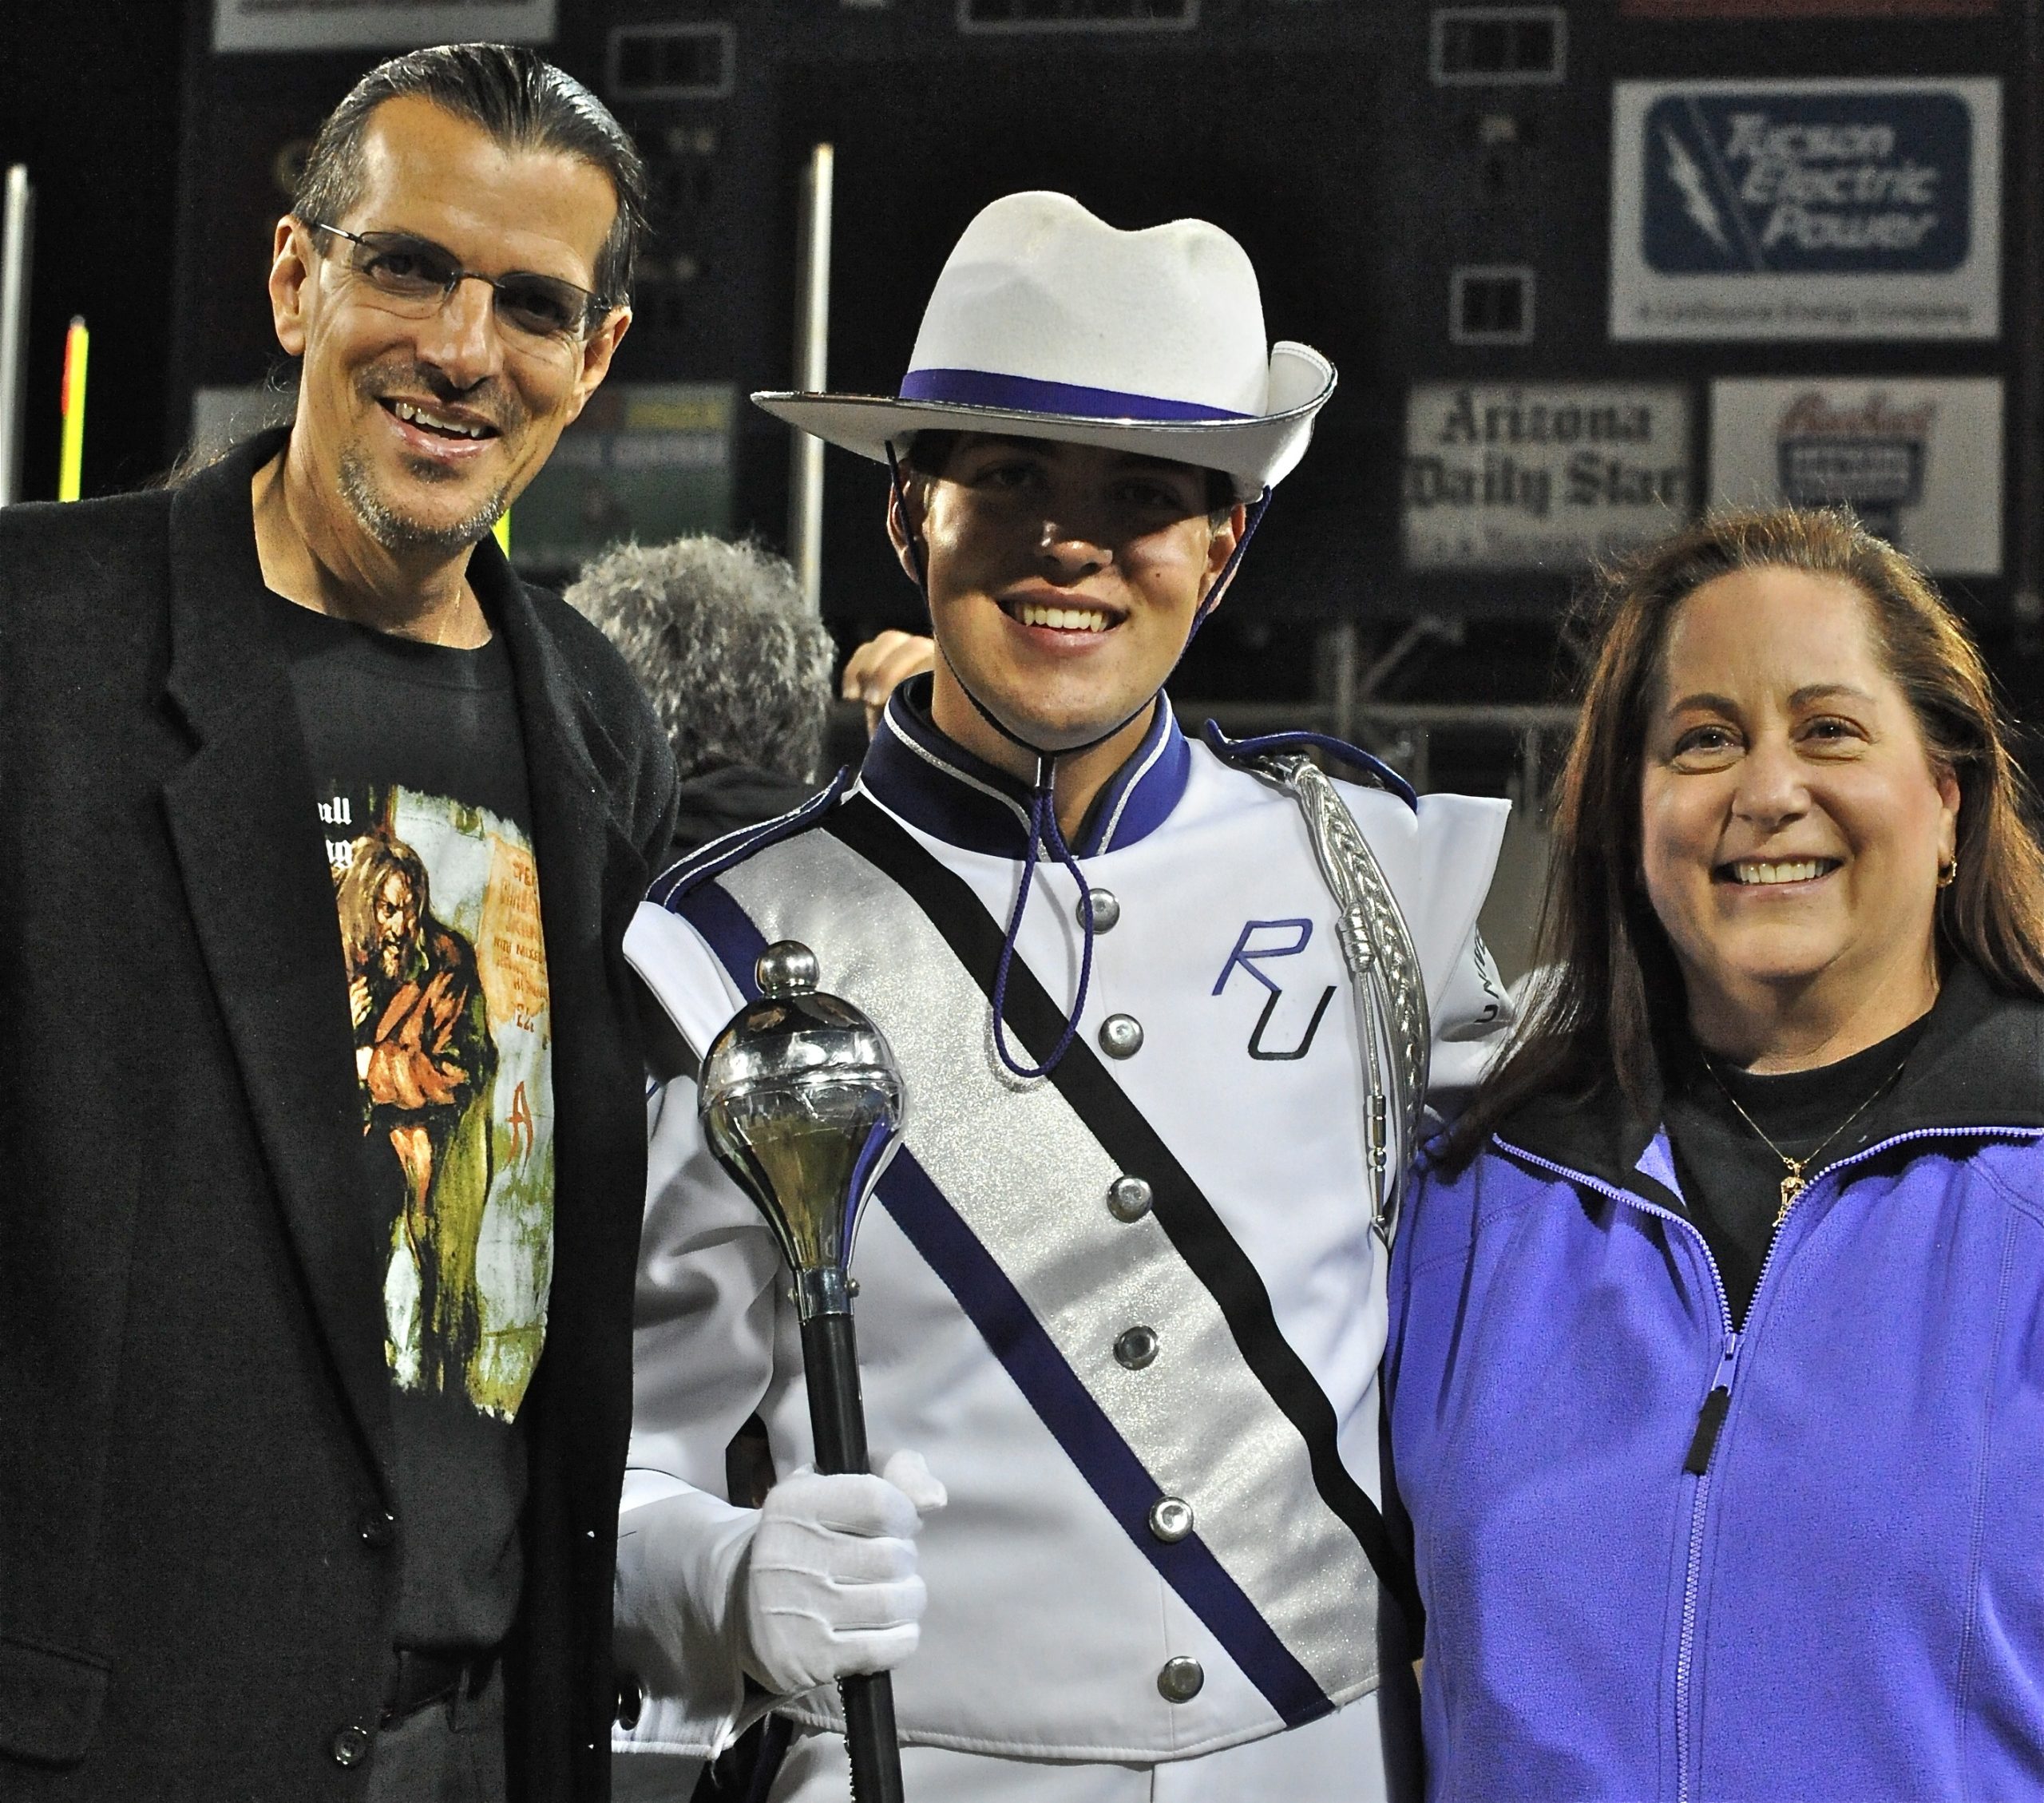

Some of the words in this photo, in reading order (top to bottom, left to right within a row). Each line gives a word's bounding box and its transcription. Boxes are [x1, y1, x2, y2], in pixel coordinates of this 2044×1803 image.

[1726, 113, 1896, 159] Tucson
[1742, 160, 1940, 203] Electric
[1761, 202, 1940, 249] Power
[1439, 386, 1652, 444] Arizona
[1407, 454, 1553, 521] Daily
[1563, 449, 1683, 506] Star
